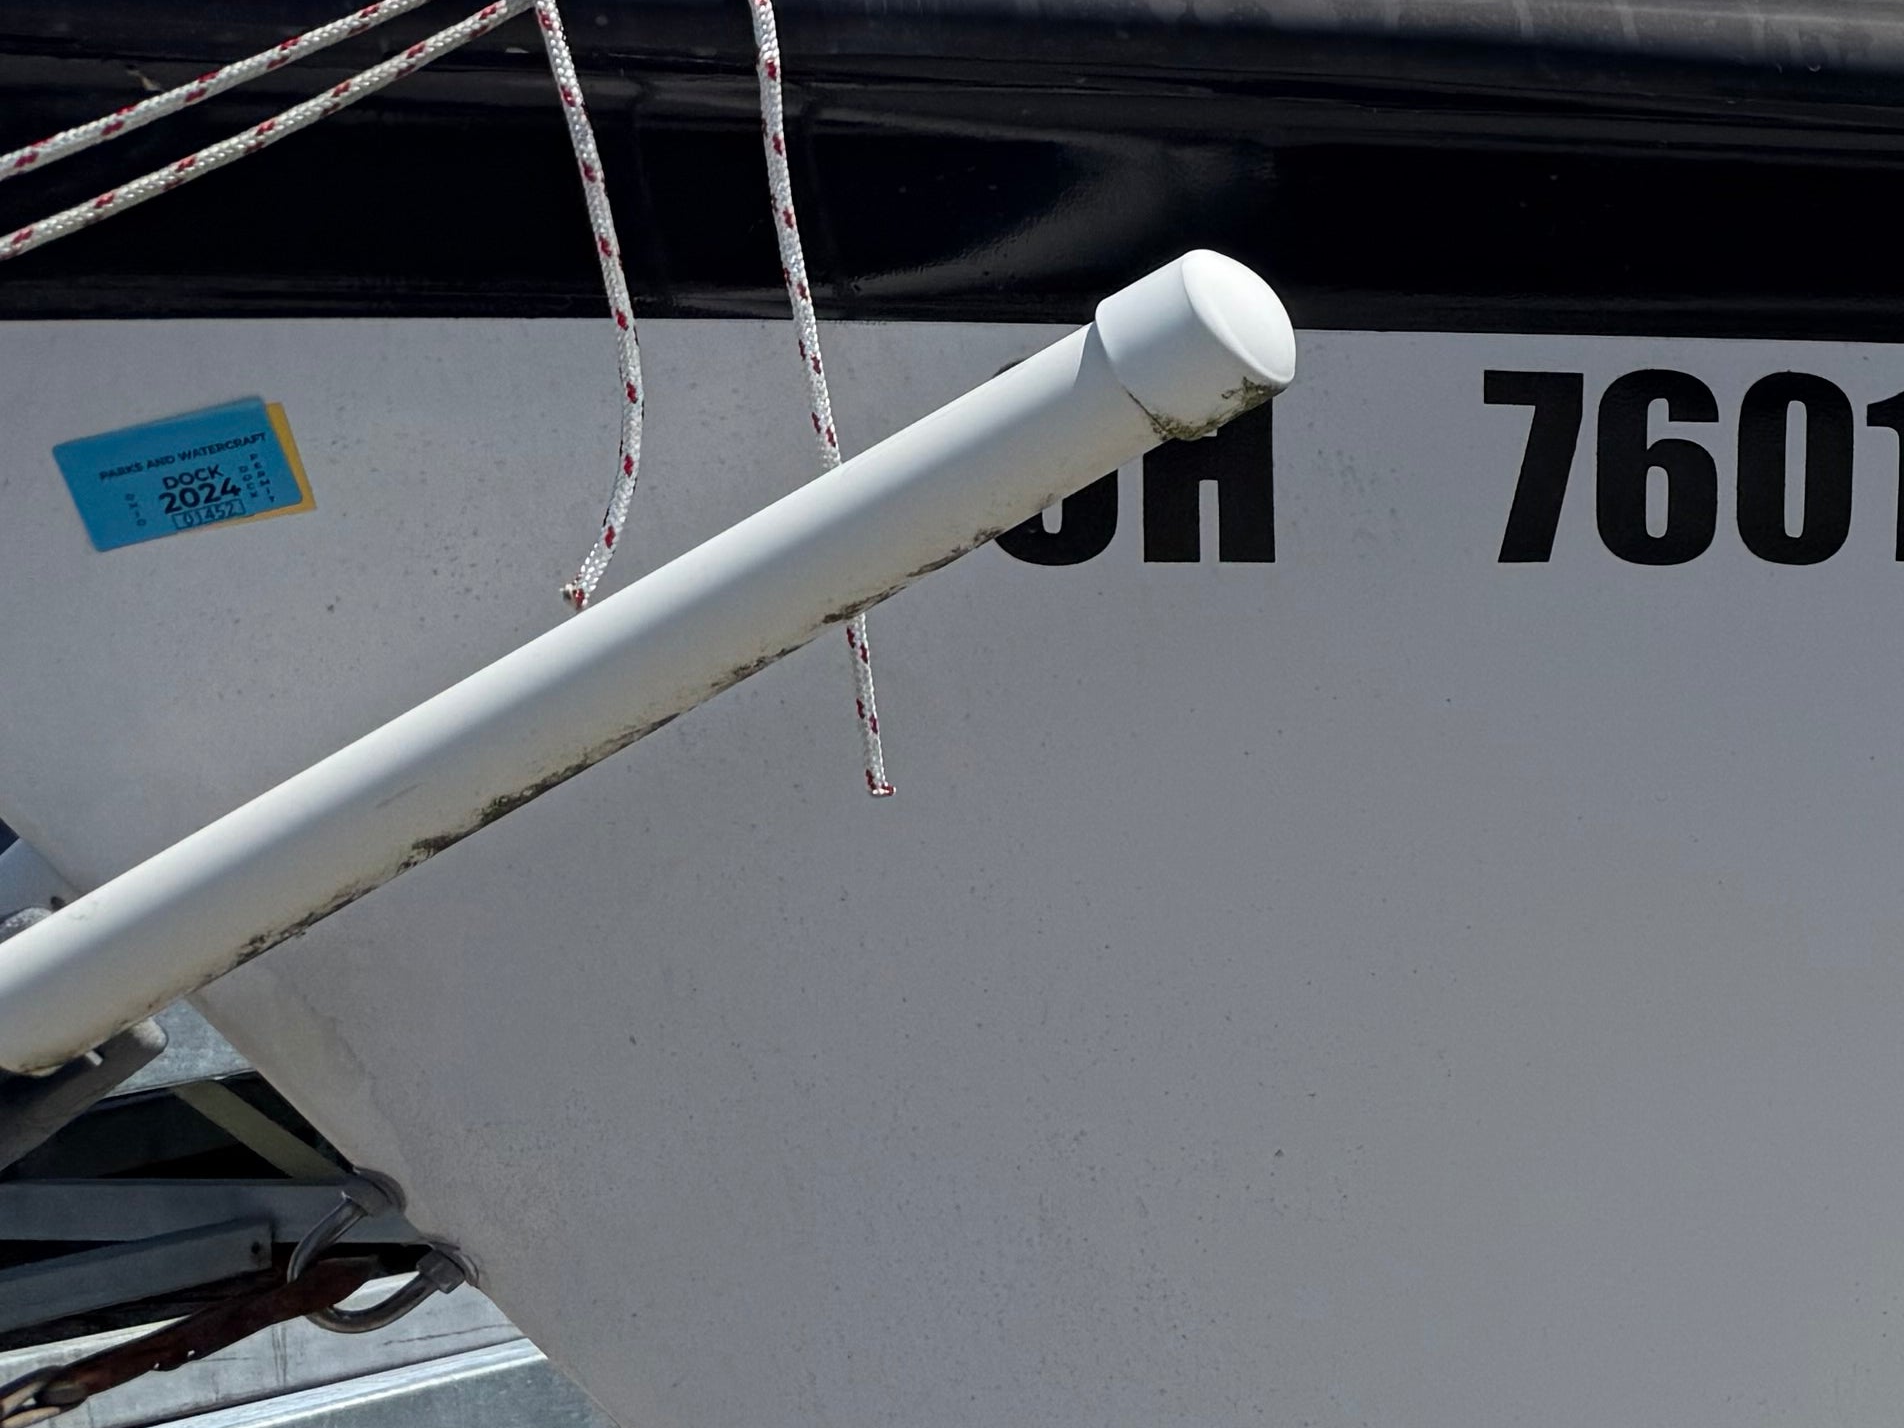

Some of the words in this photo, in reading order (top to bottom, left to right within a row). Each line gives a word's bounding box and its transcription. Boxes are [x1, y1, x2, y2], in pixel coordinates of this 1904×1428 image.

[99, 462, 143, 480] PARKS
[146, 455, 176, 470] AND
[177, 432, 266, 461] WATERCRAFT
[158, 477, 241, 514] 2024
[162, 464, 224, 490] DOCK
